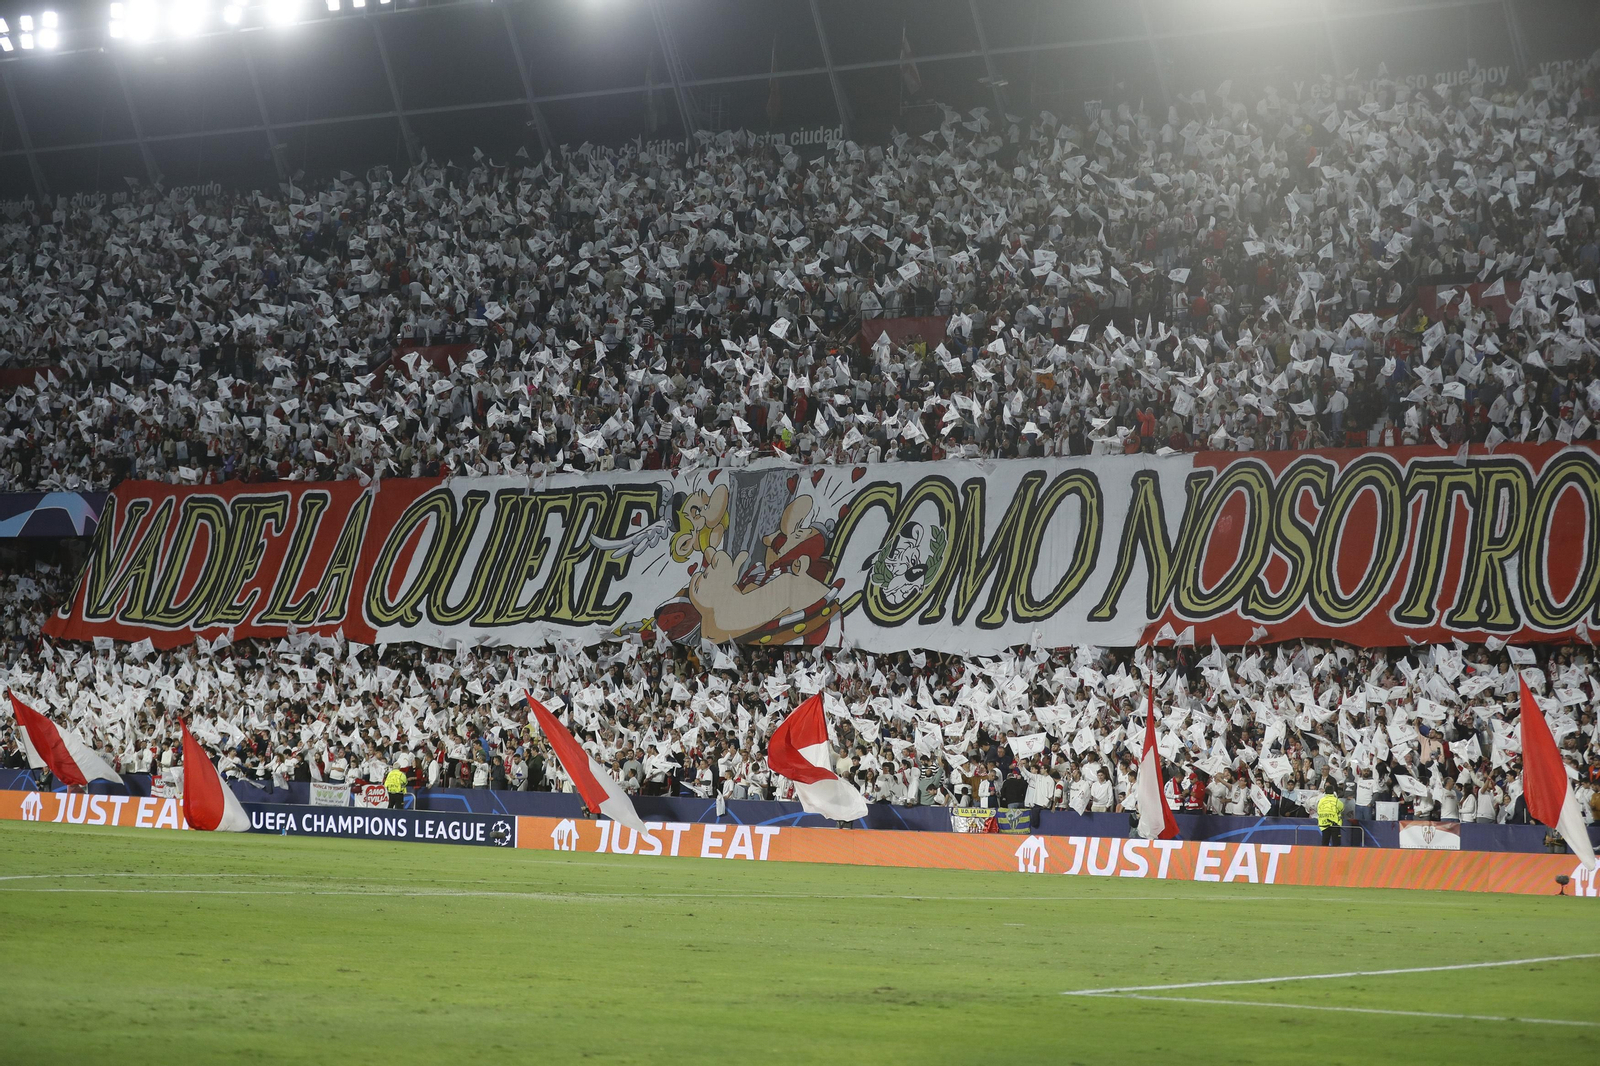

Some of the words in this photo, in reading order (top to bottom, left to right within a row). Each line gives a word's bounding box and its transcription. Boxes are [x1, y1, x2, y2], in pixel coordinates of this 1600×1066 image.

[790, 123, 843, 146] ciudad
[253, 489, 373, 627] LA
[367, 484, 663, 628] QUIERE
[826, 467, 1104, 630] COMO
[1086, 450, 1600, 634] NOSOTRO
[51, 791, 130, 827] JUST
[251, 811, 298, 832] UEFA
[302, 813, 408, 838] CHAMPIONS
[414, 819, 486, 842] LEAGUE
[595, 819, 691, 857] JUST
[700, 823, 781, 861] EAT
[1063, 836, 1184, 879] JUST
[1193, 841, 1292, 885] EAT
